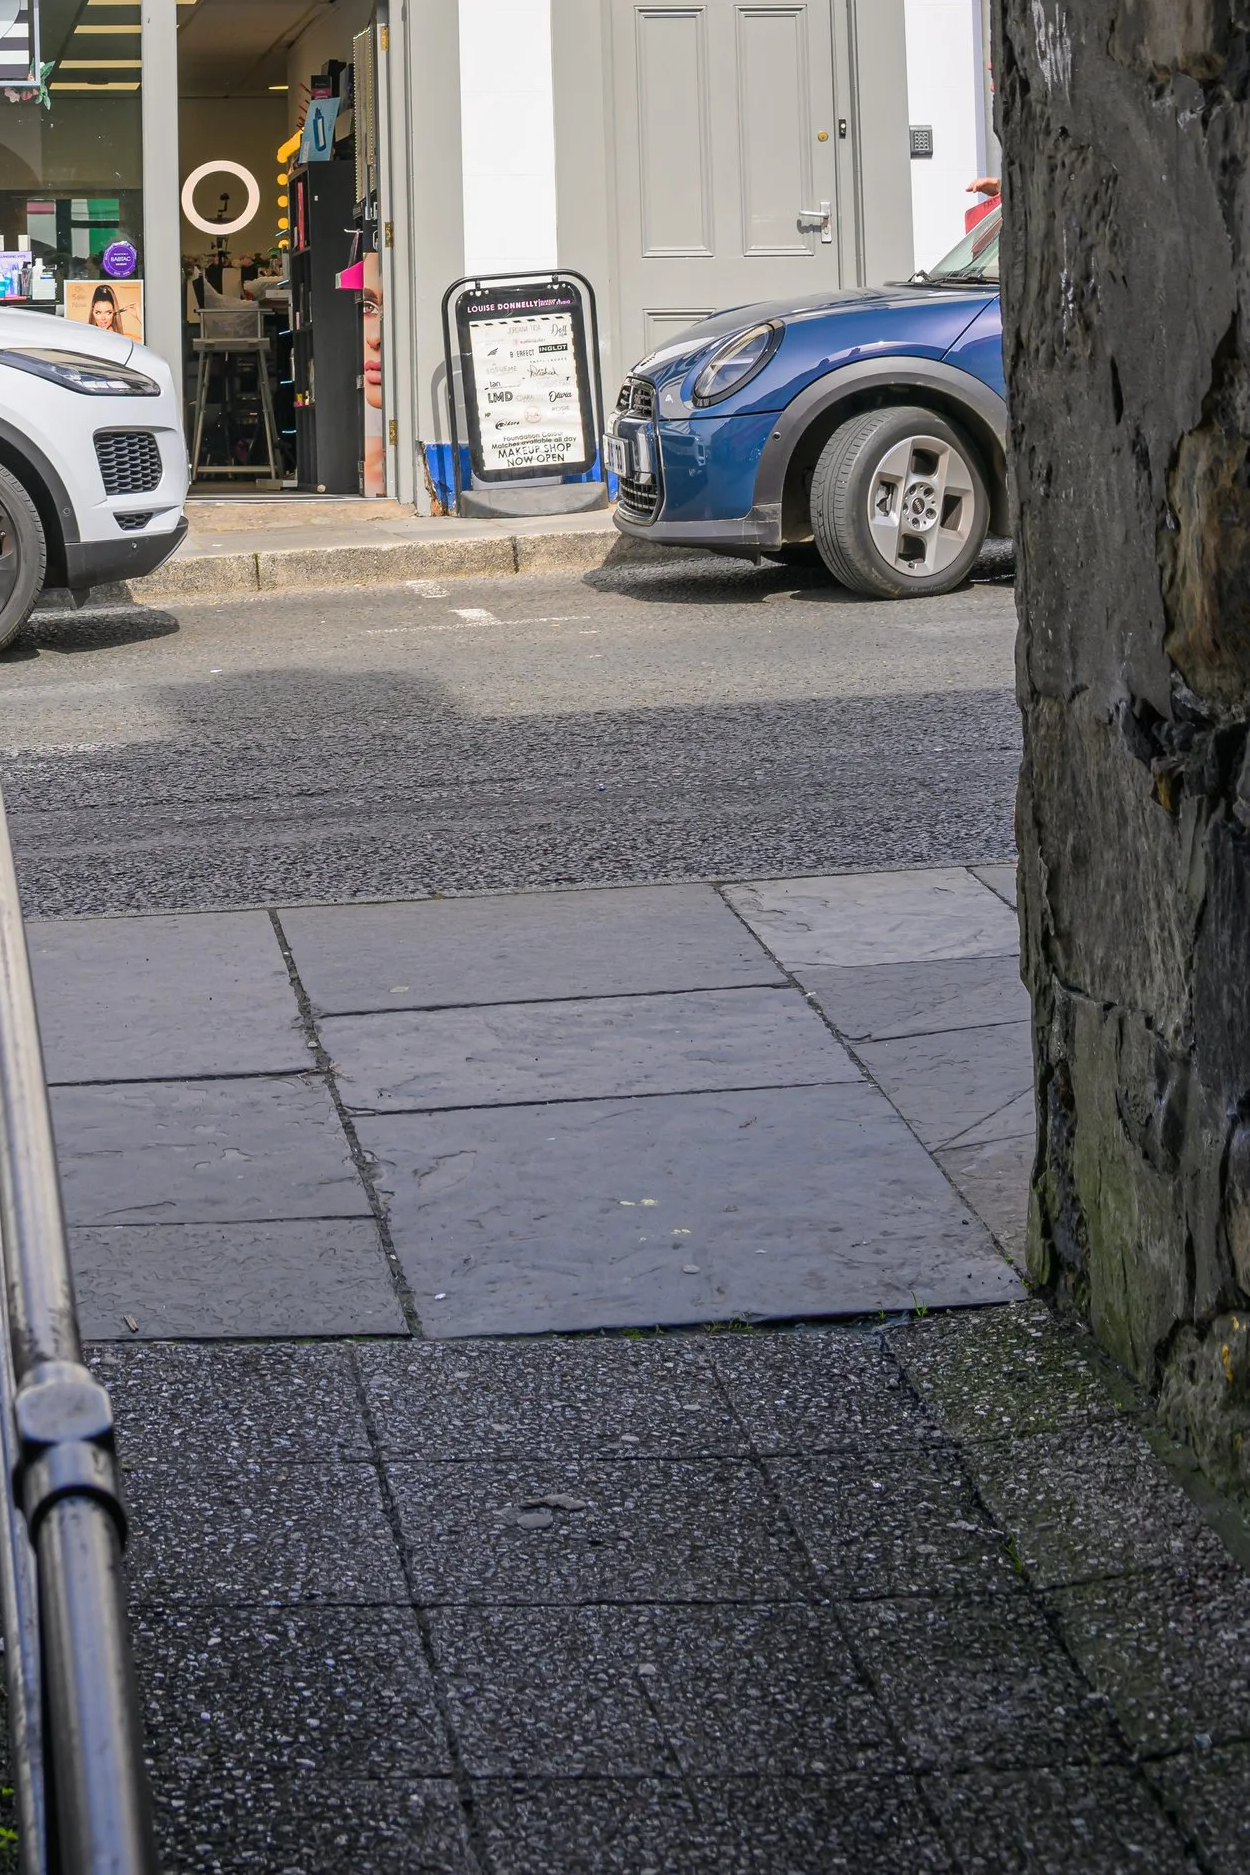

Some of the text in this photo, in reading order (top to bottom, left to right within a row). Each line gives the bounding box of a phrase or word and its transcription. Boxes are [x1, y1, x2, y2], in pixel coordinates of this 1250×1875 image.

[467, 303, 495, 313] LOUISE
[498, 300, 538, 310] DONNELLY
[539, 344, 567, 352] INGLOT
[487, 391, 513, 403] LMD
[491, 441, 520, 450] Matches
[520, 437, 552, 446] available
[563, 435, 577, 443] day
[503, 433, 540, 442] Foundation
[498, 442, 572, 459] MAKEUP SHOP
[507, 453, 565, 467] NOW OPEN
